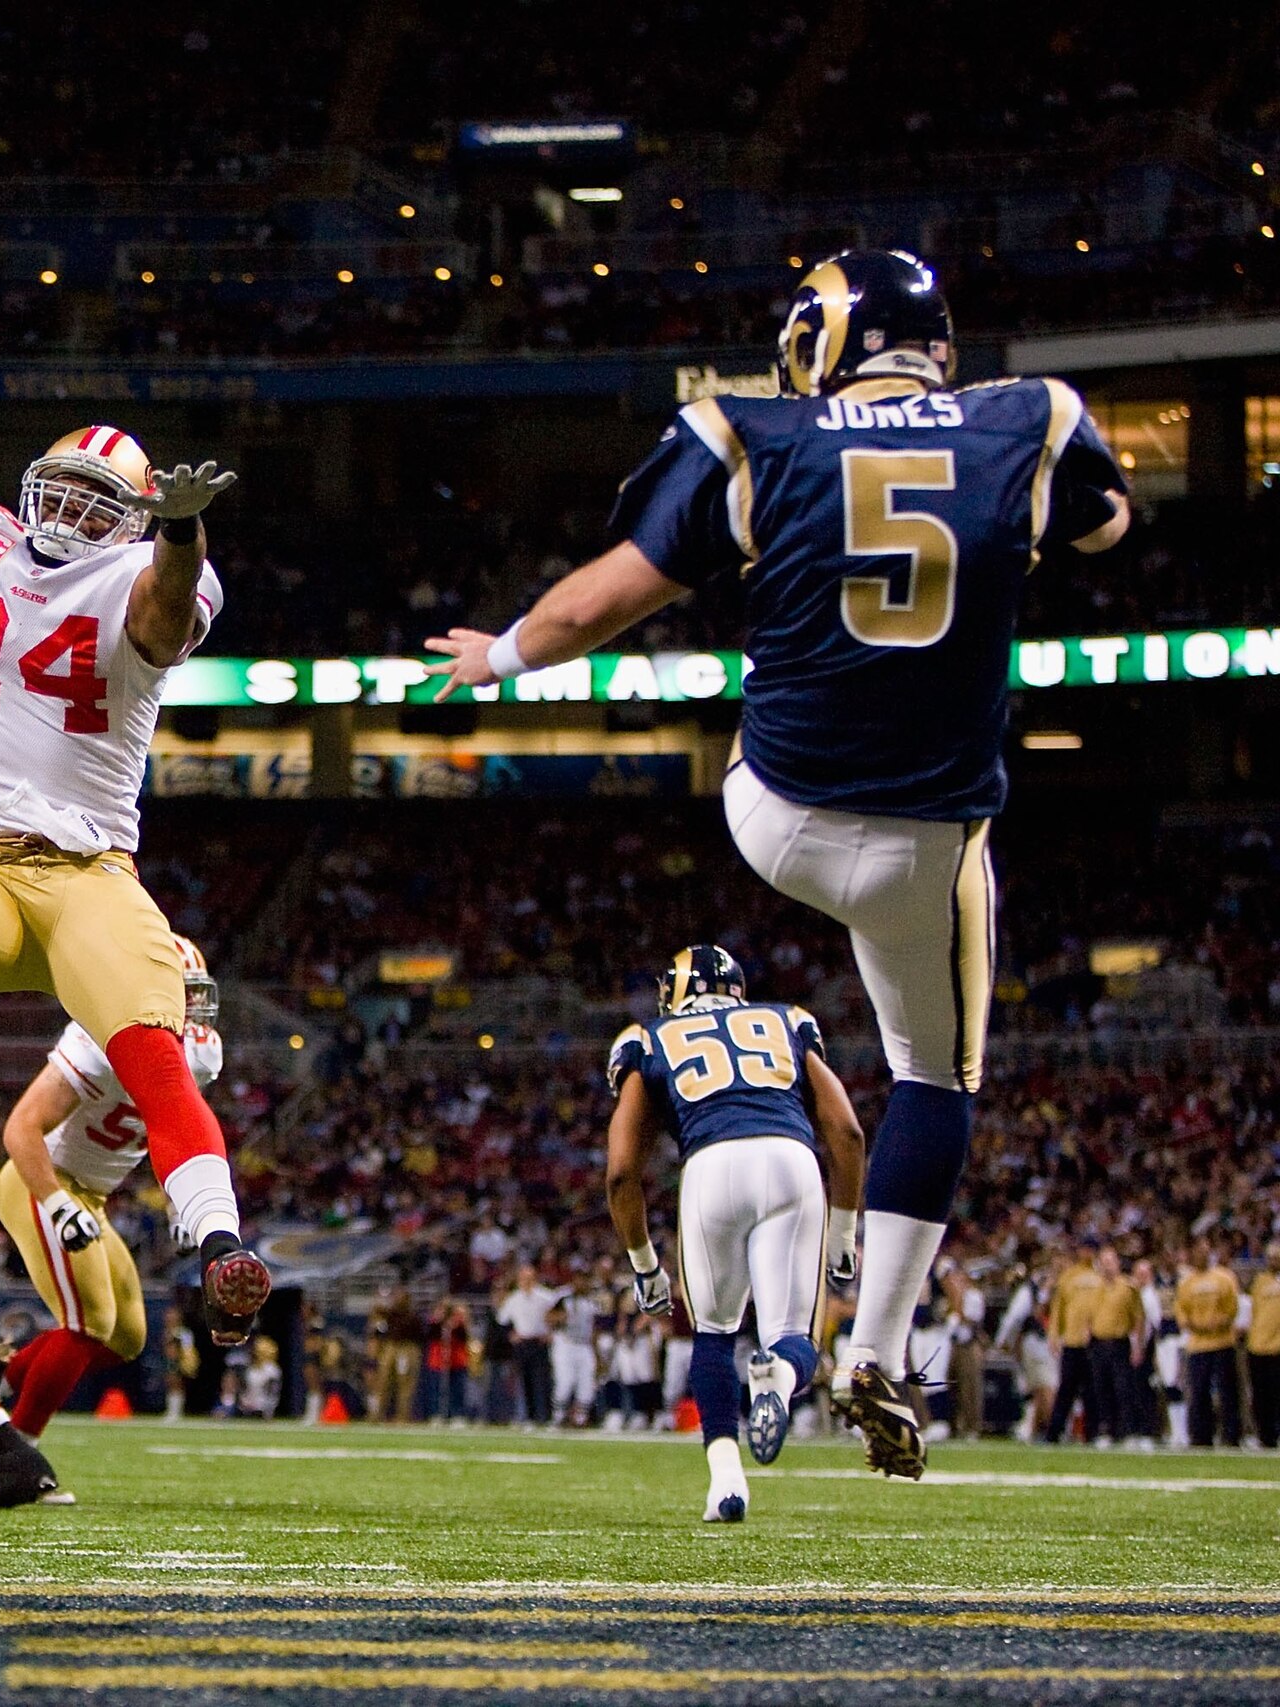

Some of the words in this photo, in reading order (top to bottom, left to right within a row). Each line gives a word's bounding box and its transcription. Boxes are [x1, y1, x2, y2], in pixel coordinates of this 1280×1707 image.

[816, 392, 964, 431] JONES
[840, 449, 958, 647] 5
[9, 585, 48, 605] 49ERS
[1018, 628, 1280, 688] UTION
[657, 1008, 798, 1102] 59
